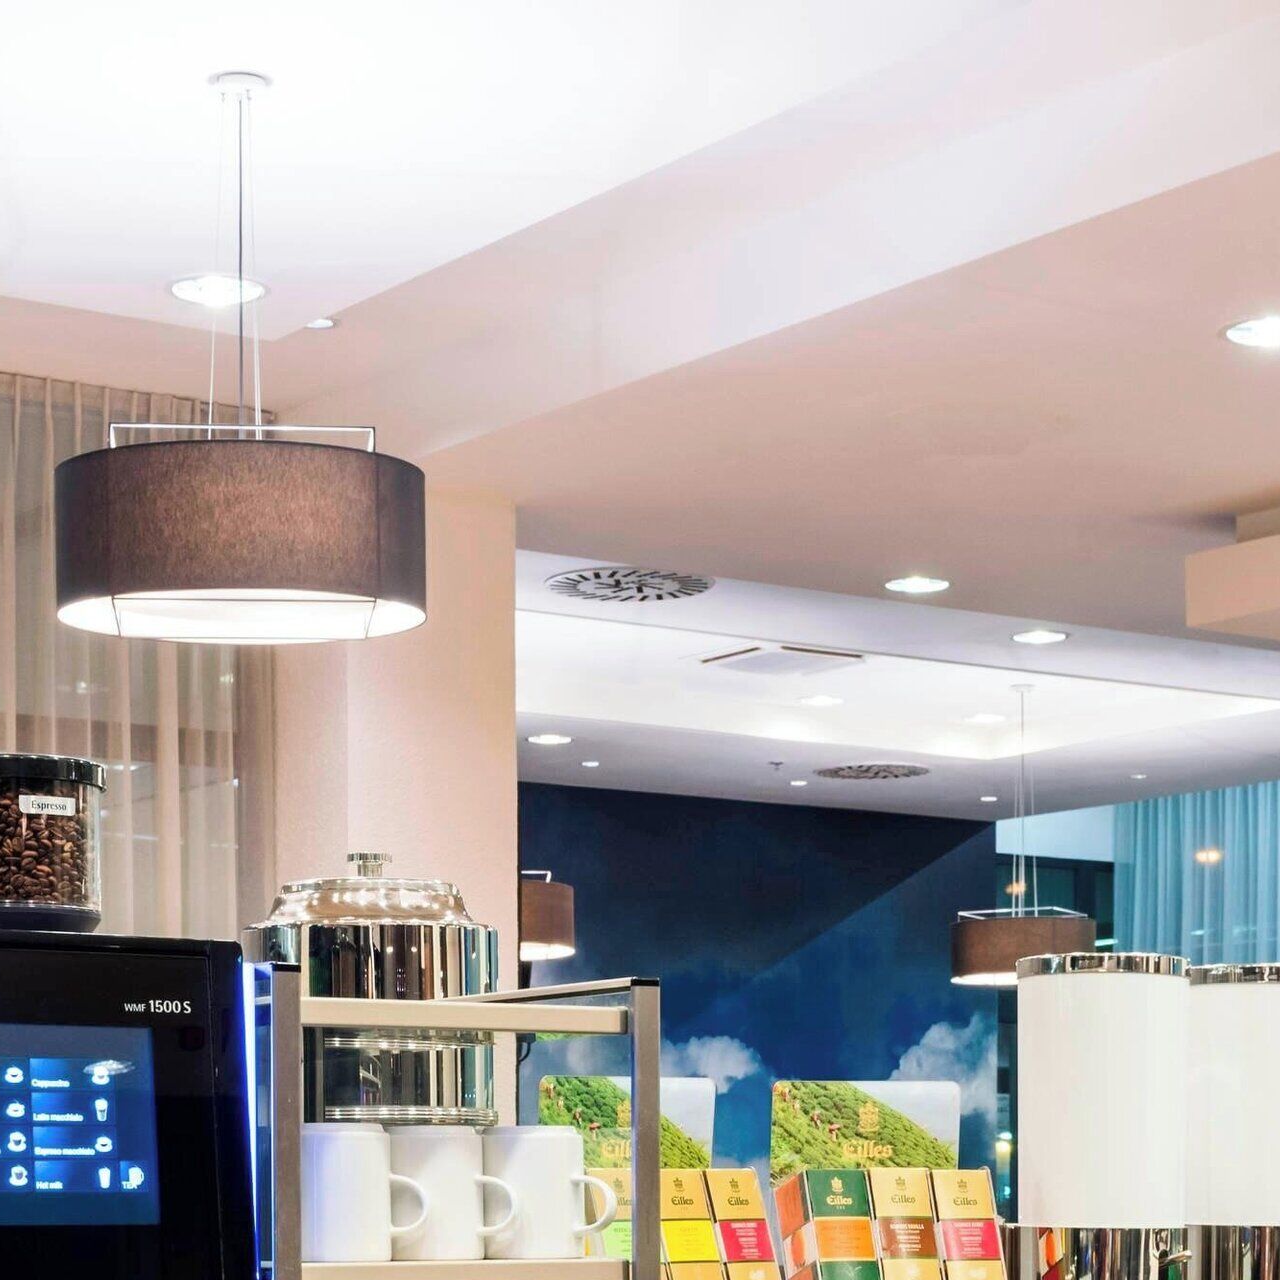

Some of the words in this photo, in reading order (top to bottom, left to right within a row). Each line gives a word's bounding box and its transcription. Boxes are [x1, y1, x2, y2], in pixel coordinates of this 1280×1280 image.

[31, 800, 68, 812] Espresso
[124, 1003, 147, 1012] WMF
[842, 1140, 893, 1160] Eilles
[671, 1196, 694, 1206] Eilles
[727, 1196, 750, 1206] Eilles
[826, 1194, 853, 1205] Eilles
[891, 1194, 916, 1204] Eilles
[953, 1197, 978, 1206] Eilles
